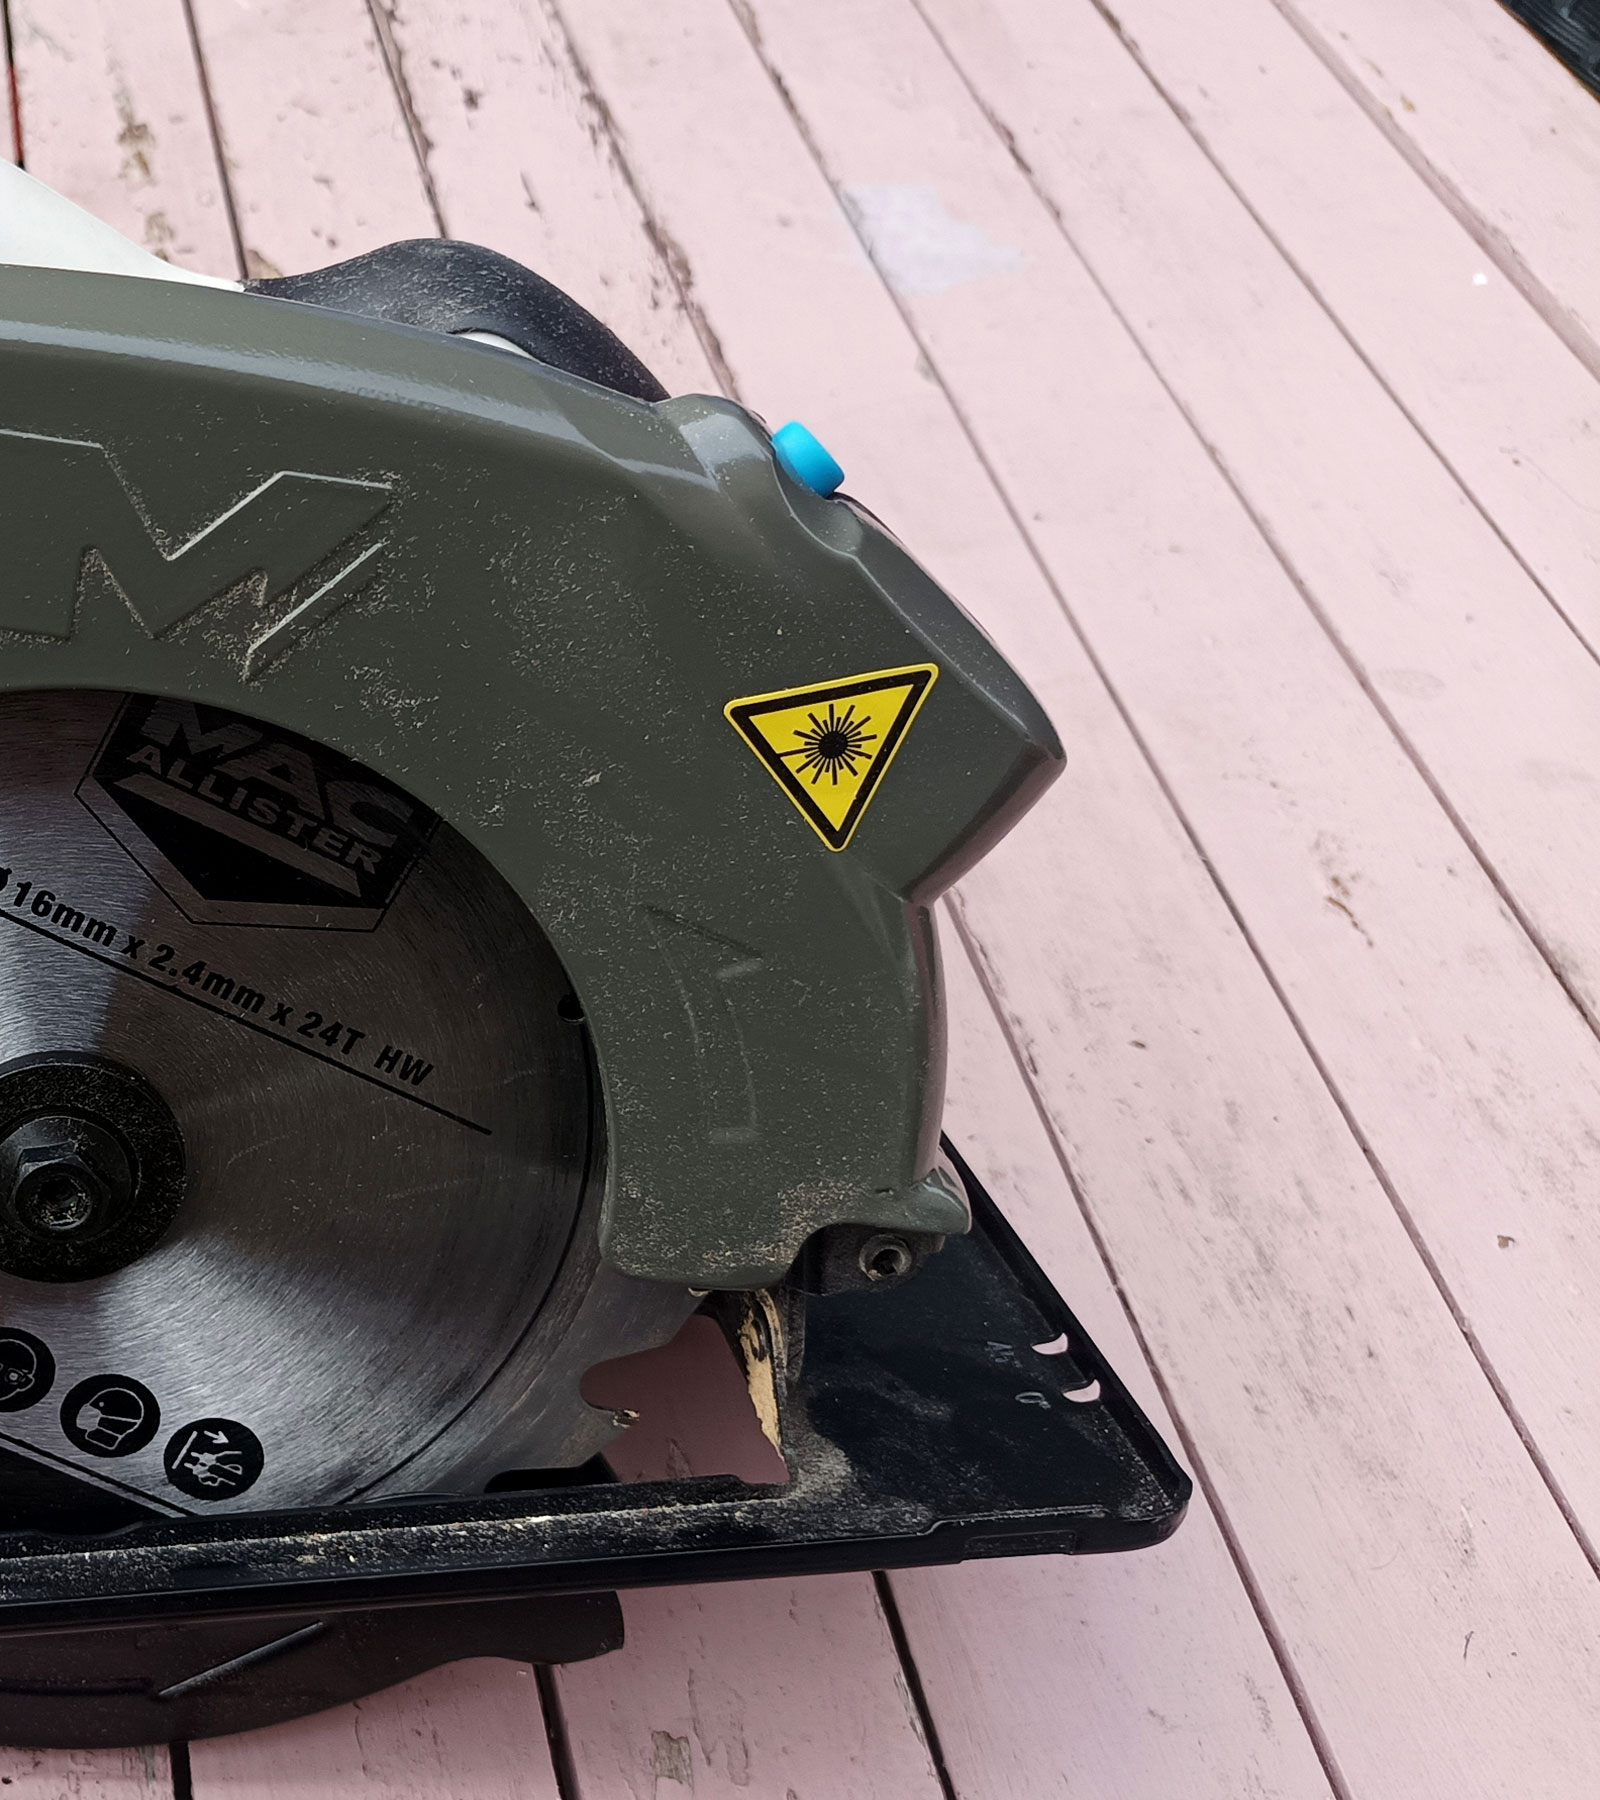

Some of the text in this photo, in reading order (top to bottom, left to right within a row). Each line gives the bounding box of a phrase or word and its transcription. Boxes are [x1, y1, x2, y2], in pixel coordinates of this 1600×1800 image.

[126, 745, 383, 875] ALLISTER
[139, 697, 415, 848] MAC
[120, 935, 146, 959] x
[148, 944, 267, 1014] 2.4mm
[268, 1002, 294, 1027] x
[297, 1011, 366, 1055] 24T
[374, 1045, 434, 1086] HW
